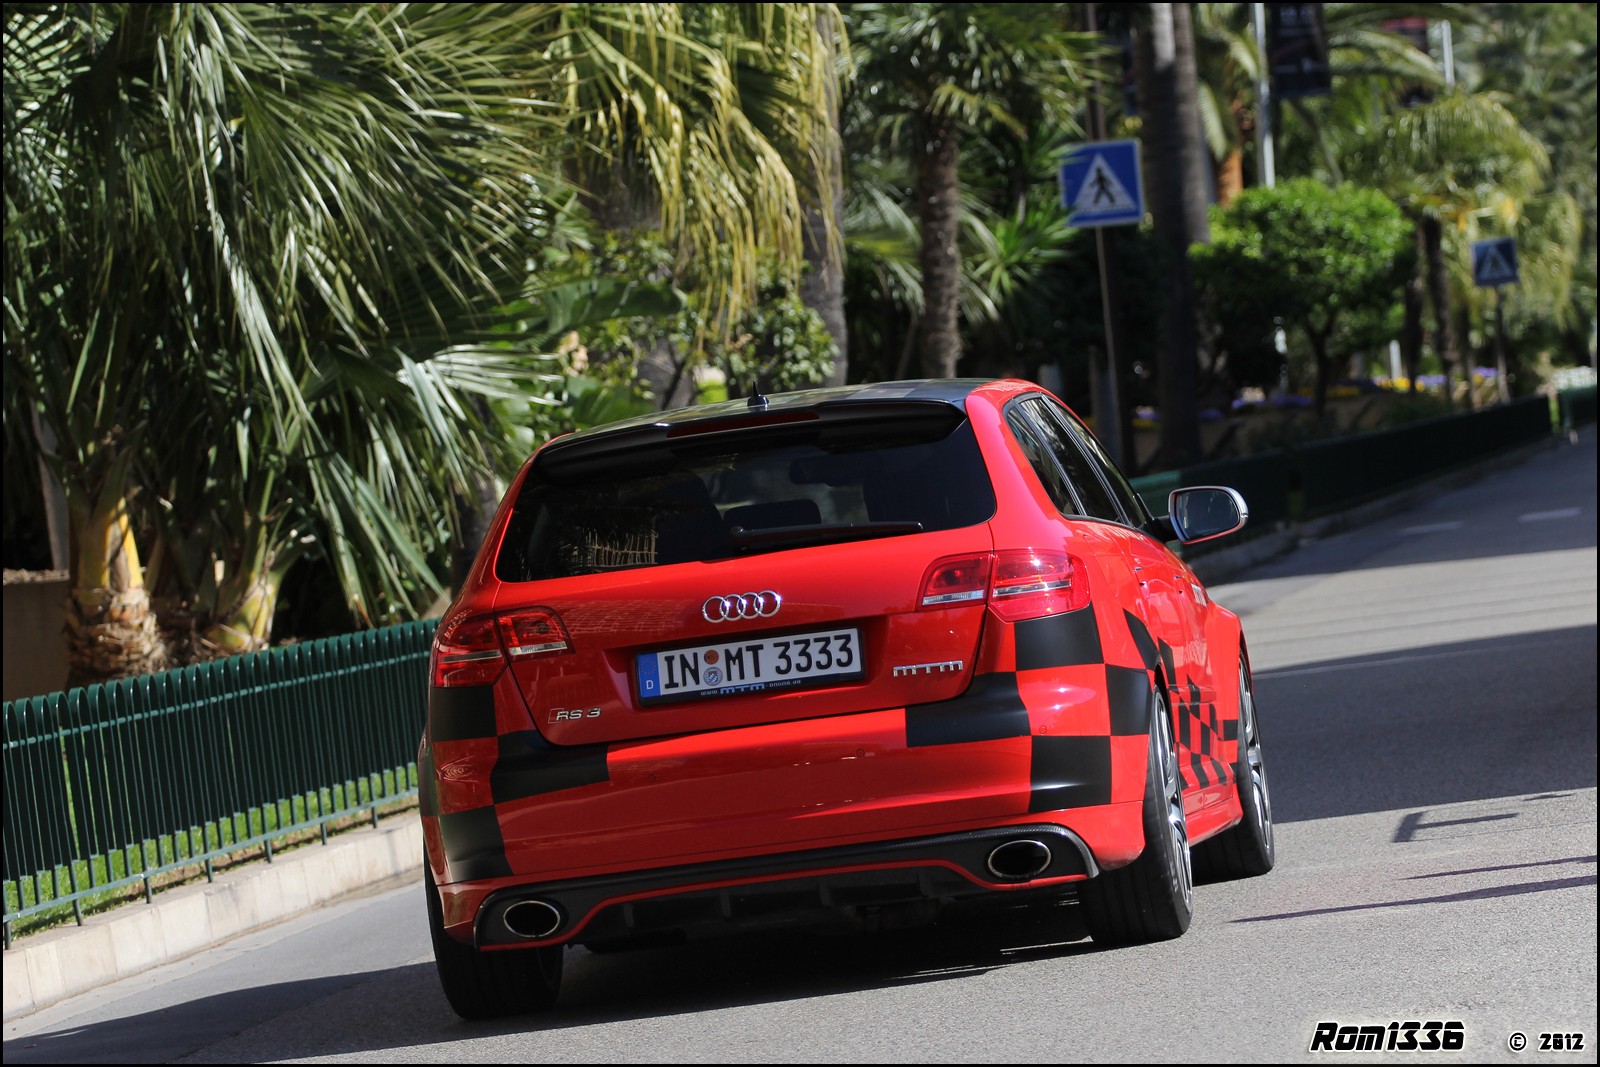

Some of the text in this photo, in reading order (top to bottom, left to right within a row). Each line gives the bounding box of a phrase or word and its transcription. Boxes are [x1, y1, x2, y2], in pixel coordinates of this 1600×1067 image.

[664, 634, 854, 689] IN MT 3333
[646, 680, 654, 690] D
[556, 707, 602, 721] RS 3
